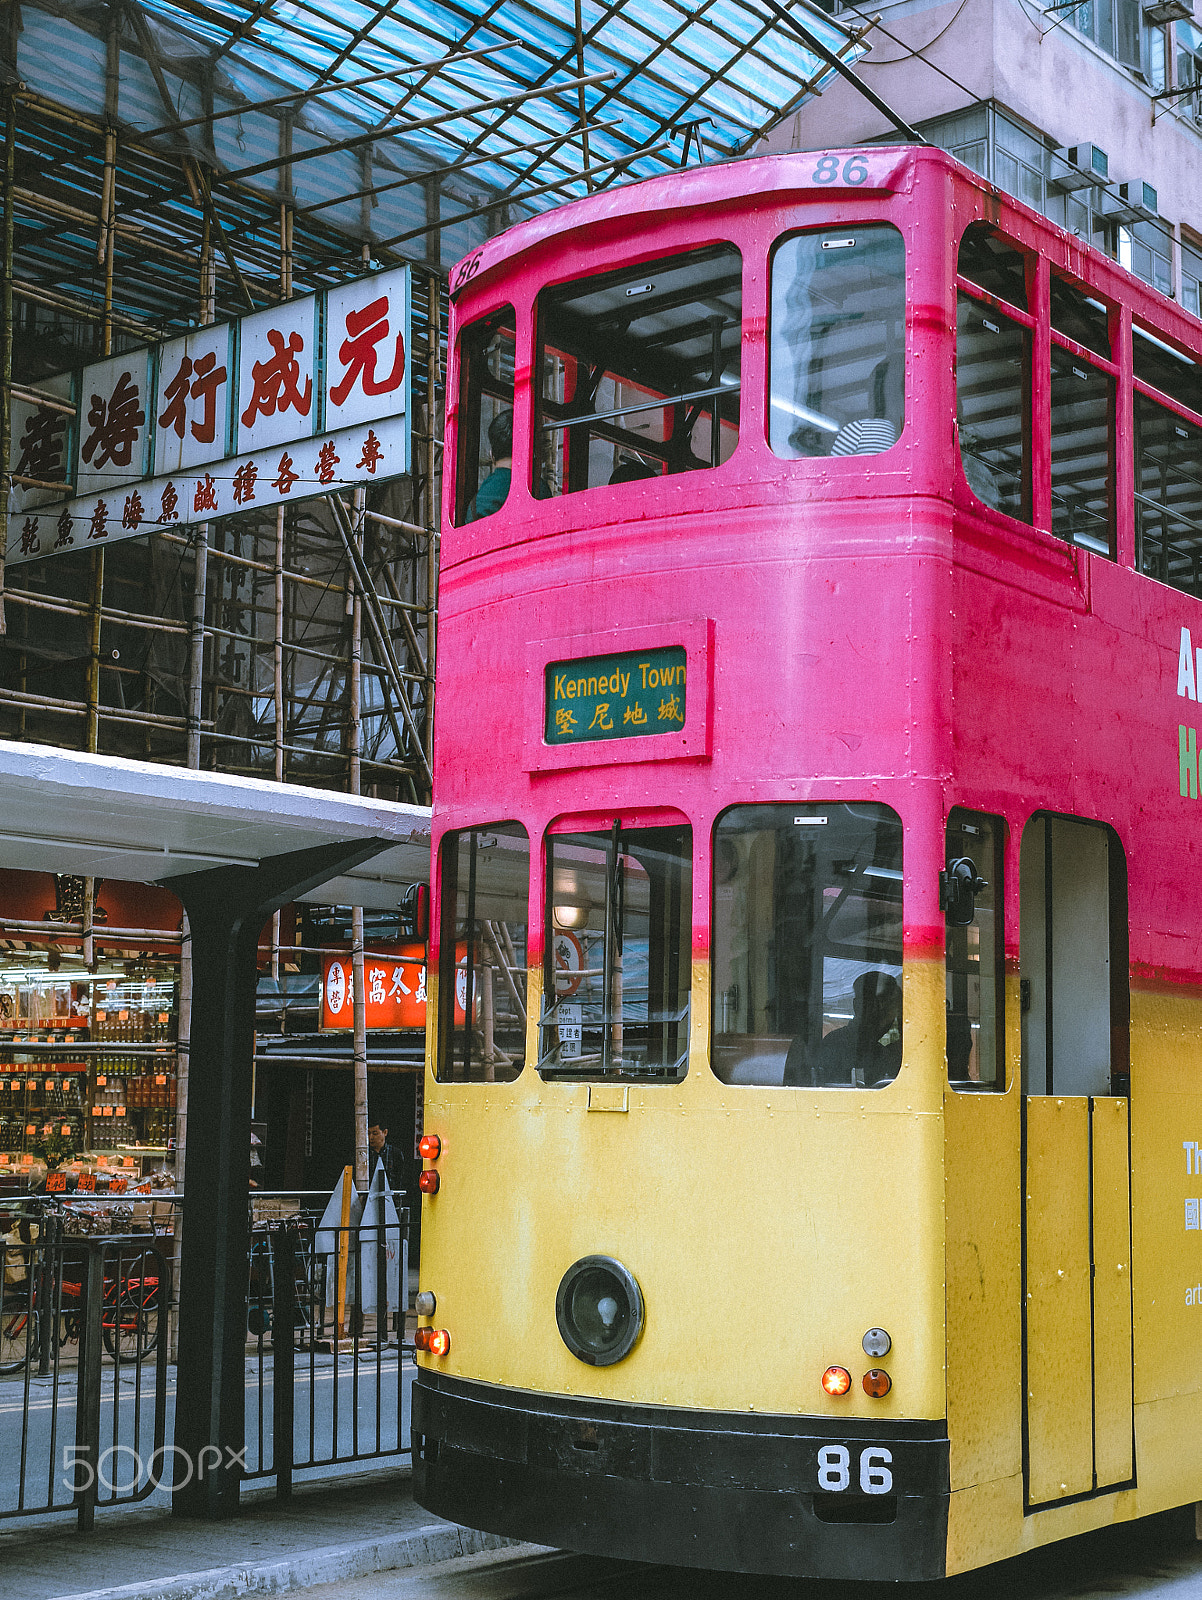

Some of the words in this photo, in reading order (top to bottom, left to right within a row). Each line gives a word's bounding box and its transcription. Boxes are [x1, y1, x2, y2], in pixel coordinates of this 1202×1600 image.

[811, 155, 869, 186] 86
[454, 251, 481, 289] 86
[554, 667, 630, 700] Kennedy
[638, 663, 687, 690] Town
[1177, 626, 1202, 703] A
[555, 693, 684, 735] 堅尼地城
[1178, 724, 1202, 800] H
[1184, 1198, 1202, 1231] 國
[817, 1444, 893, 1495] 86
